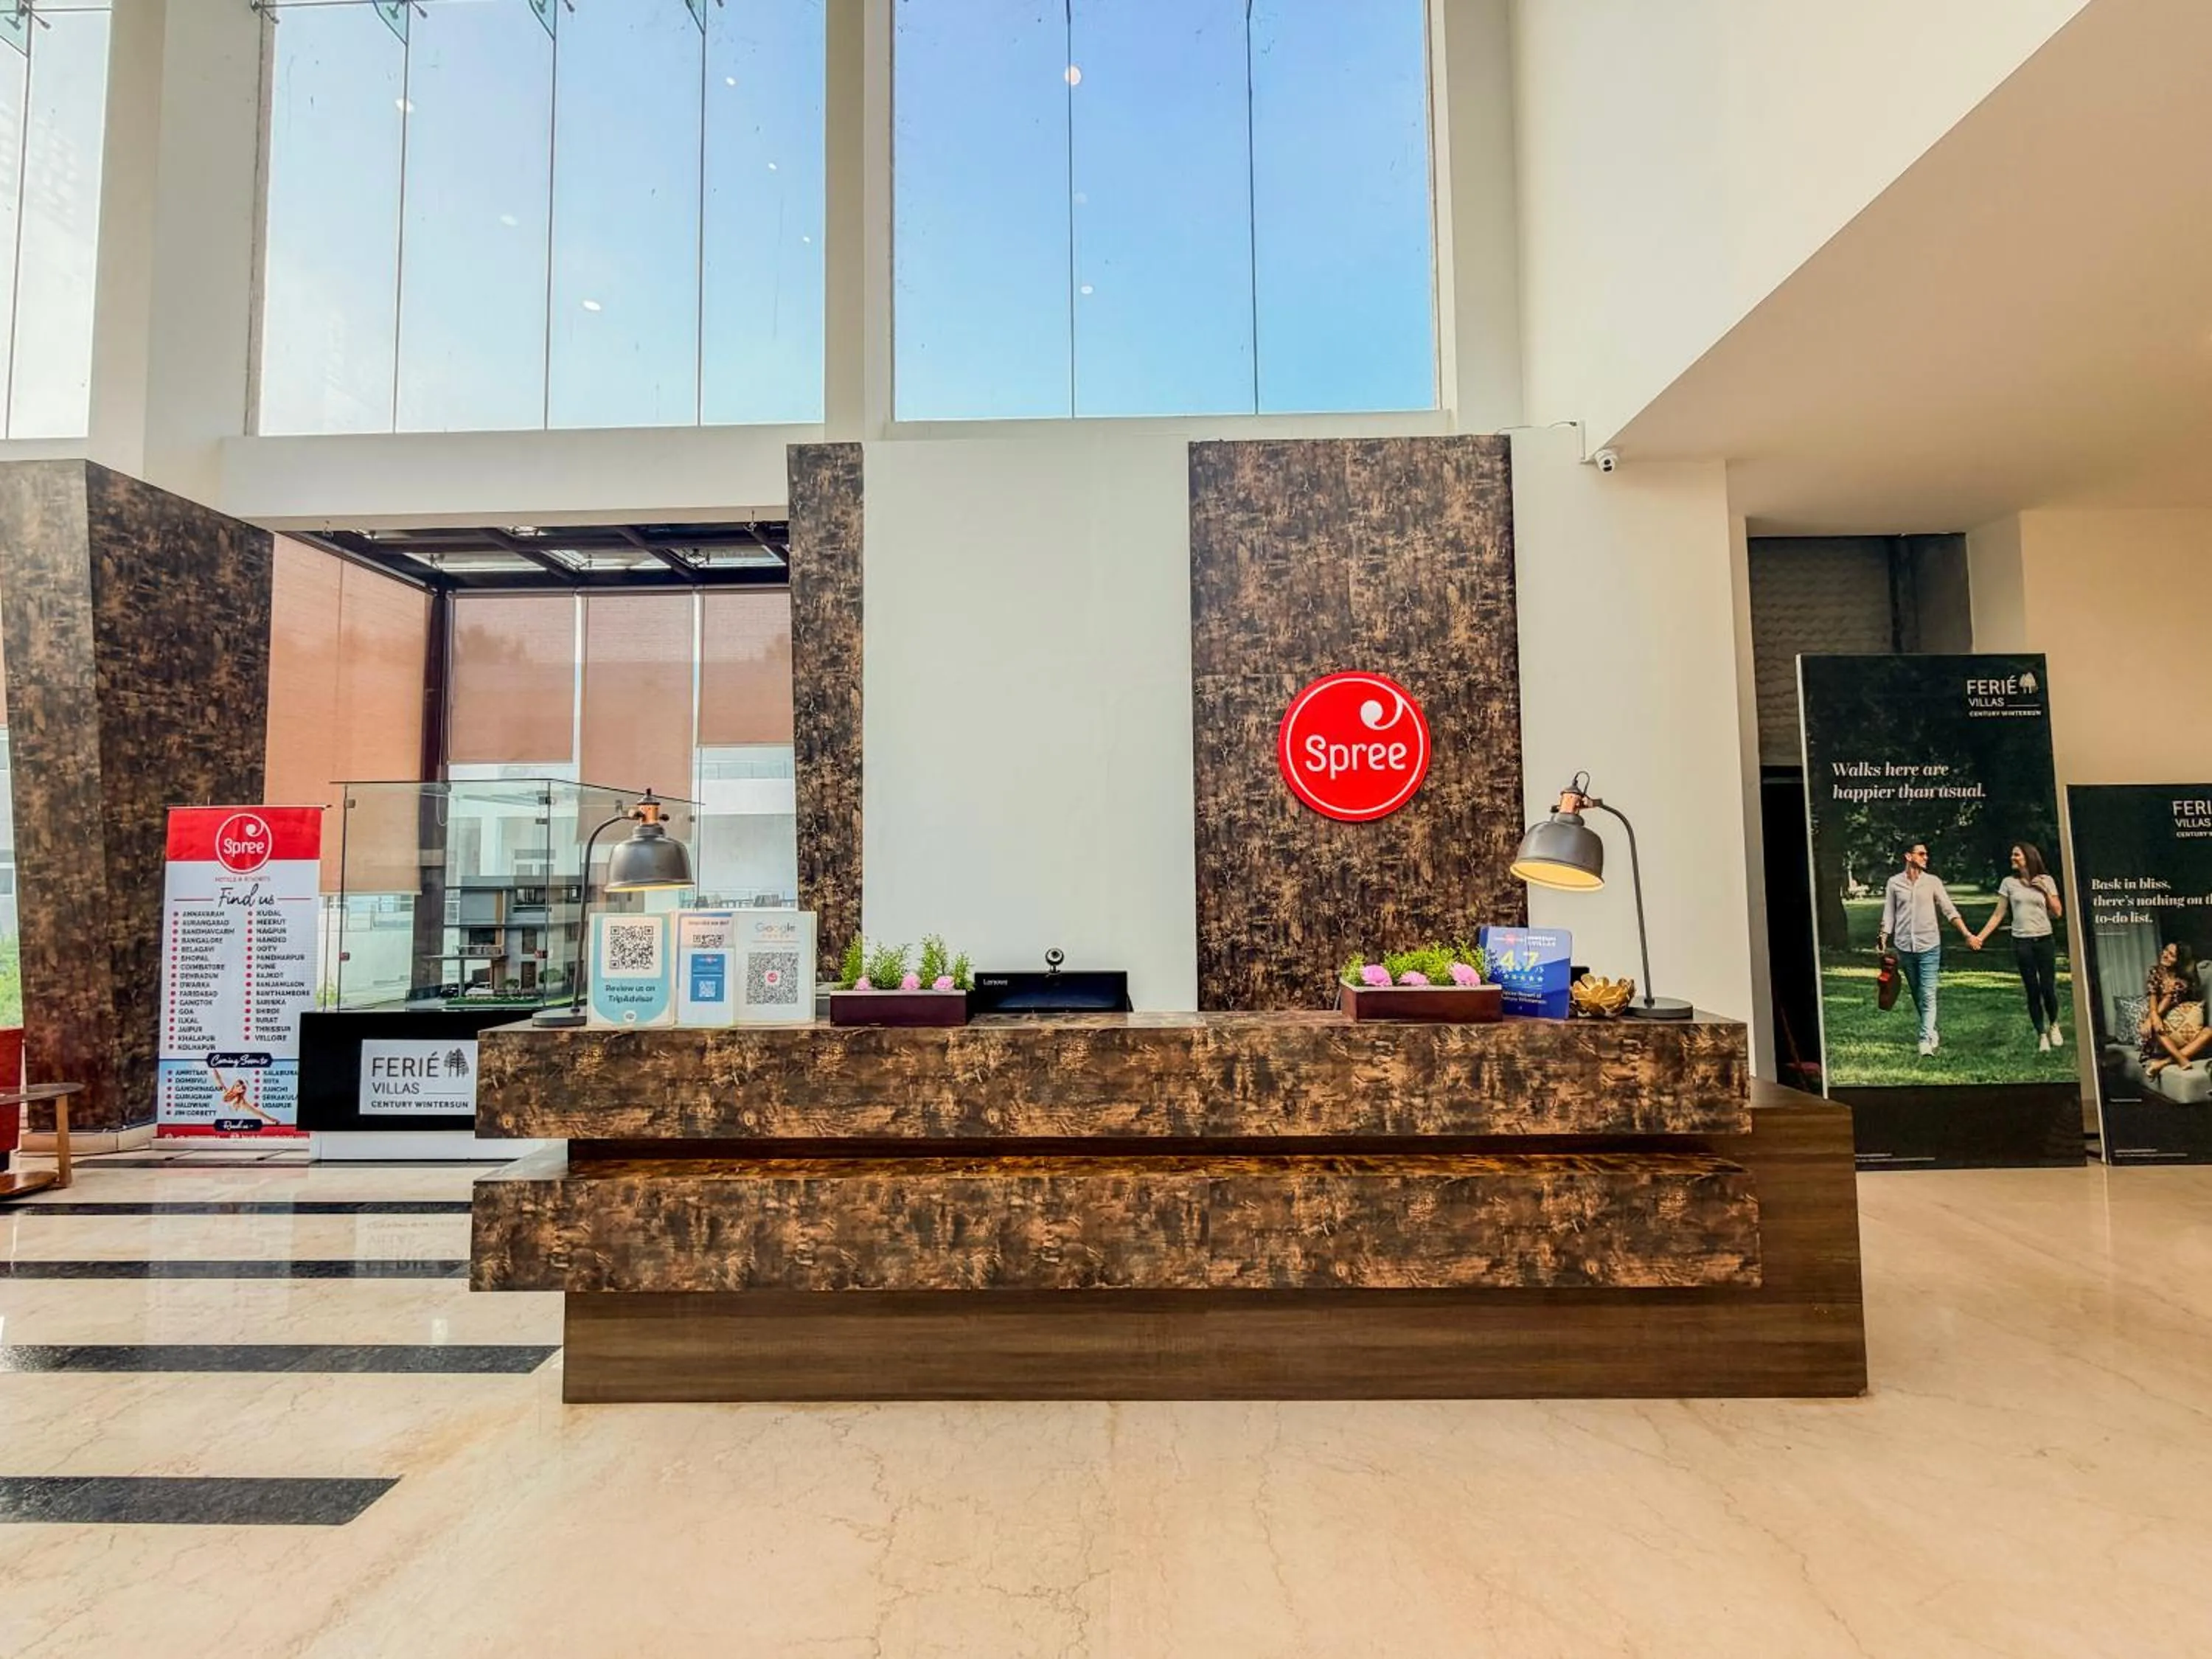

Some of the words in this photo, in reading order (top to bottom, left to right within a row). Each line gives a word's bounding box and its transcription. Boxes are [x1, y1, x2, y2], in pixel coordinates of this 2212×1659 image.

[1966, 675, 2017, 695] FERIÉ
[1968, 697, 2004, 707] VILLAS
[1305, 734, 1408, 780] Spree
[1832, 761, 1881, 776] Walks
[1885, 761, 1919, 776] here
[1923, 765, 1949, 776] are
[1832, 784, 1895, 803] happier
[1899, 783, 1935, 799] than
[1938, 782, 1986, 799] usual.
[2172, 800, 2212, 815] FERI
[2174, 818, 2211, 828] VILLAS
[223, 838, 265, 858] Spree
[2092, 877, 2122, 890] Bask
[2124, 878, 2136, 889] in
[218, 883, 258, 908] Find
[259, 894, 274, 905] us
[2093, 894, 2135, 906] there's
[2136, 894, 2185, 908] nothing
[2095, 911, 2128, 923] to-do
[2130, 911, 2153, 923] list.
[372, 1051, 440, 1077] FERIÉ
[372, 1082, 420, 1094] VILLAS
